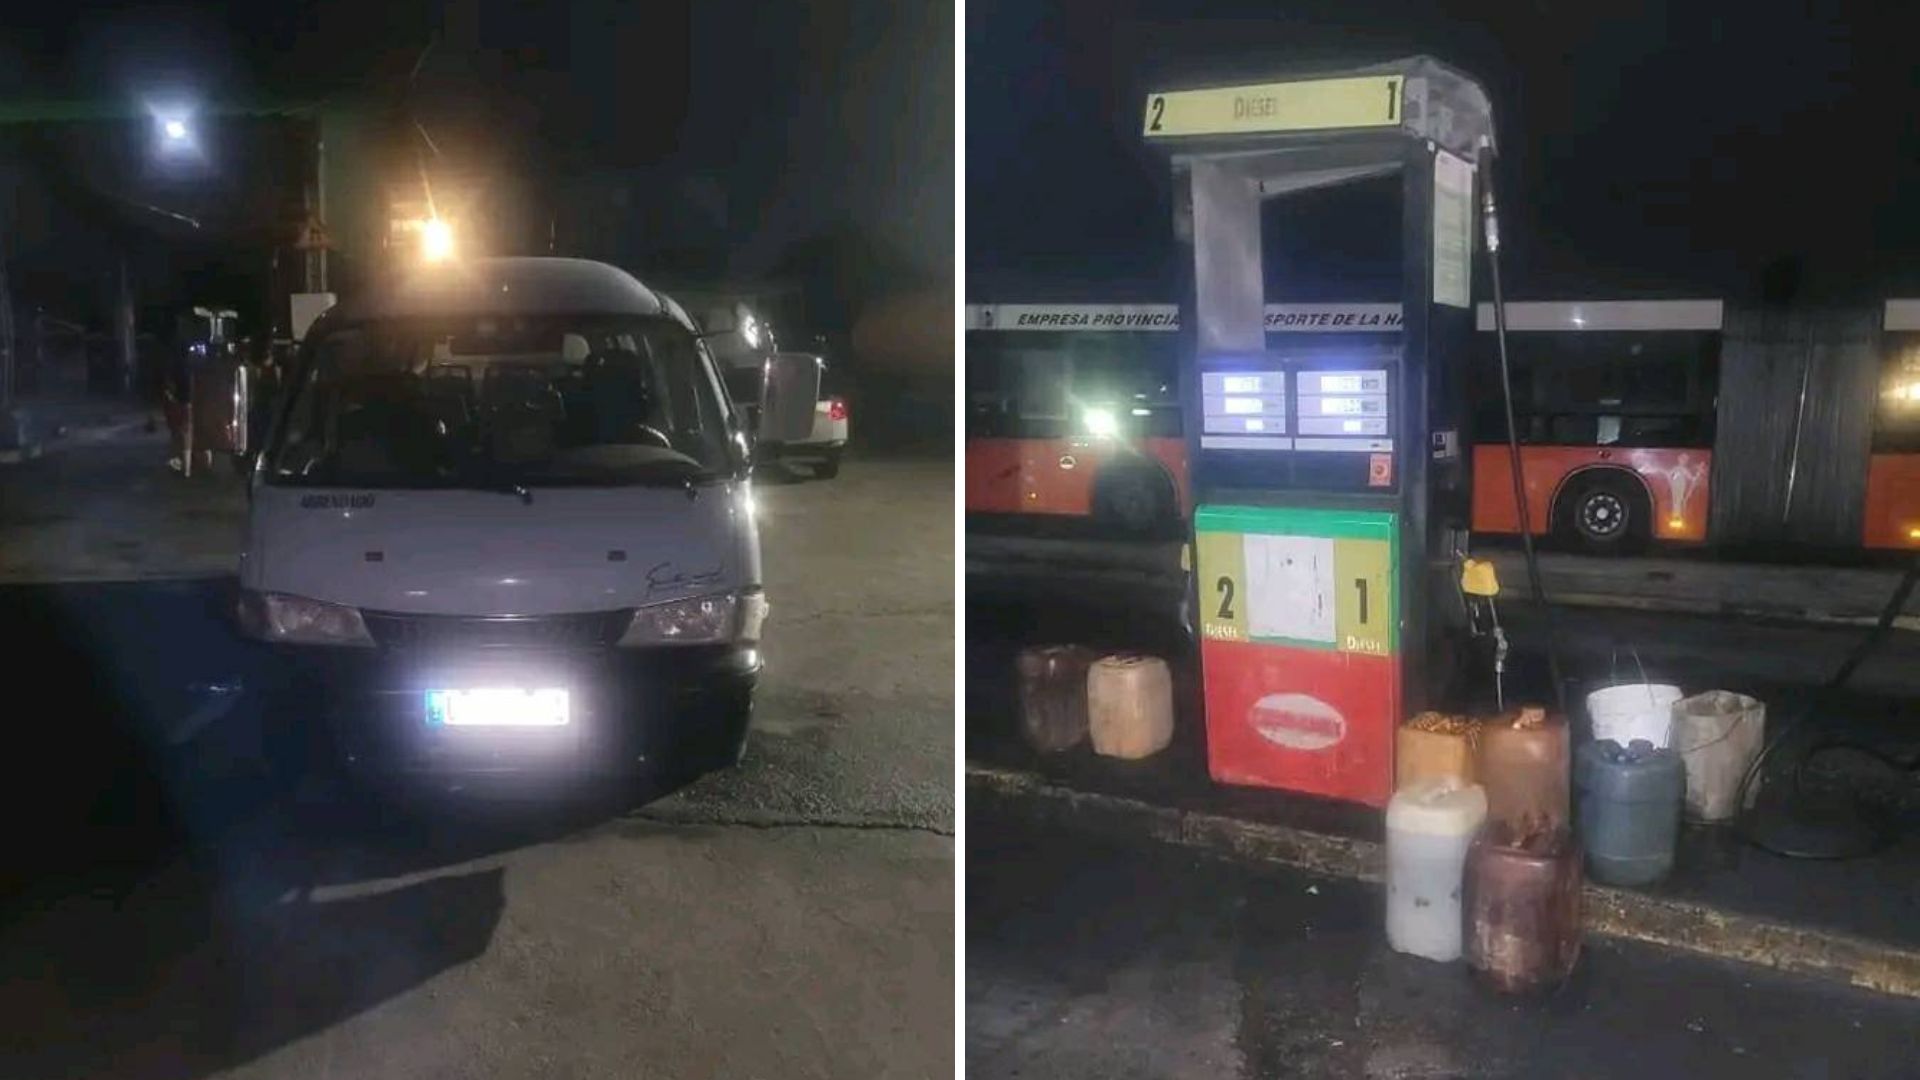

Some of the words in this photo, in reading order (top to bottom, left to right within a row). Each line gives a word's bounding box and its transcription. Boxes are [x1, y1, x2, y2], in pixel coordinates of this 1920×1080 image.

[1150, 97, 1165, 131] 2
[1387, 81, 1397, 120] 1
[1018, 313, 1089, 325] EMPRESA
[1332, 313, 1355, 326] DE
[1359, 314, 1380, 326] LA
[1216, 576, 1235, 619] 2
[1354, 578, 1368, 624] 1
